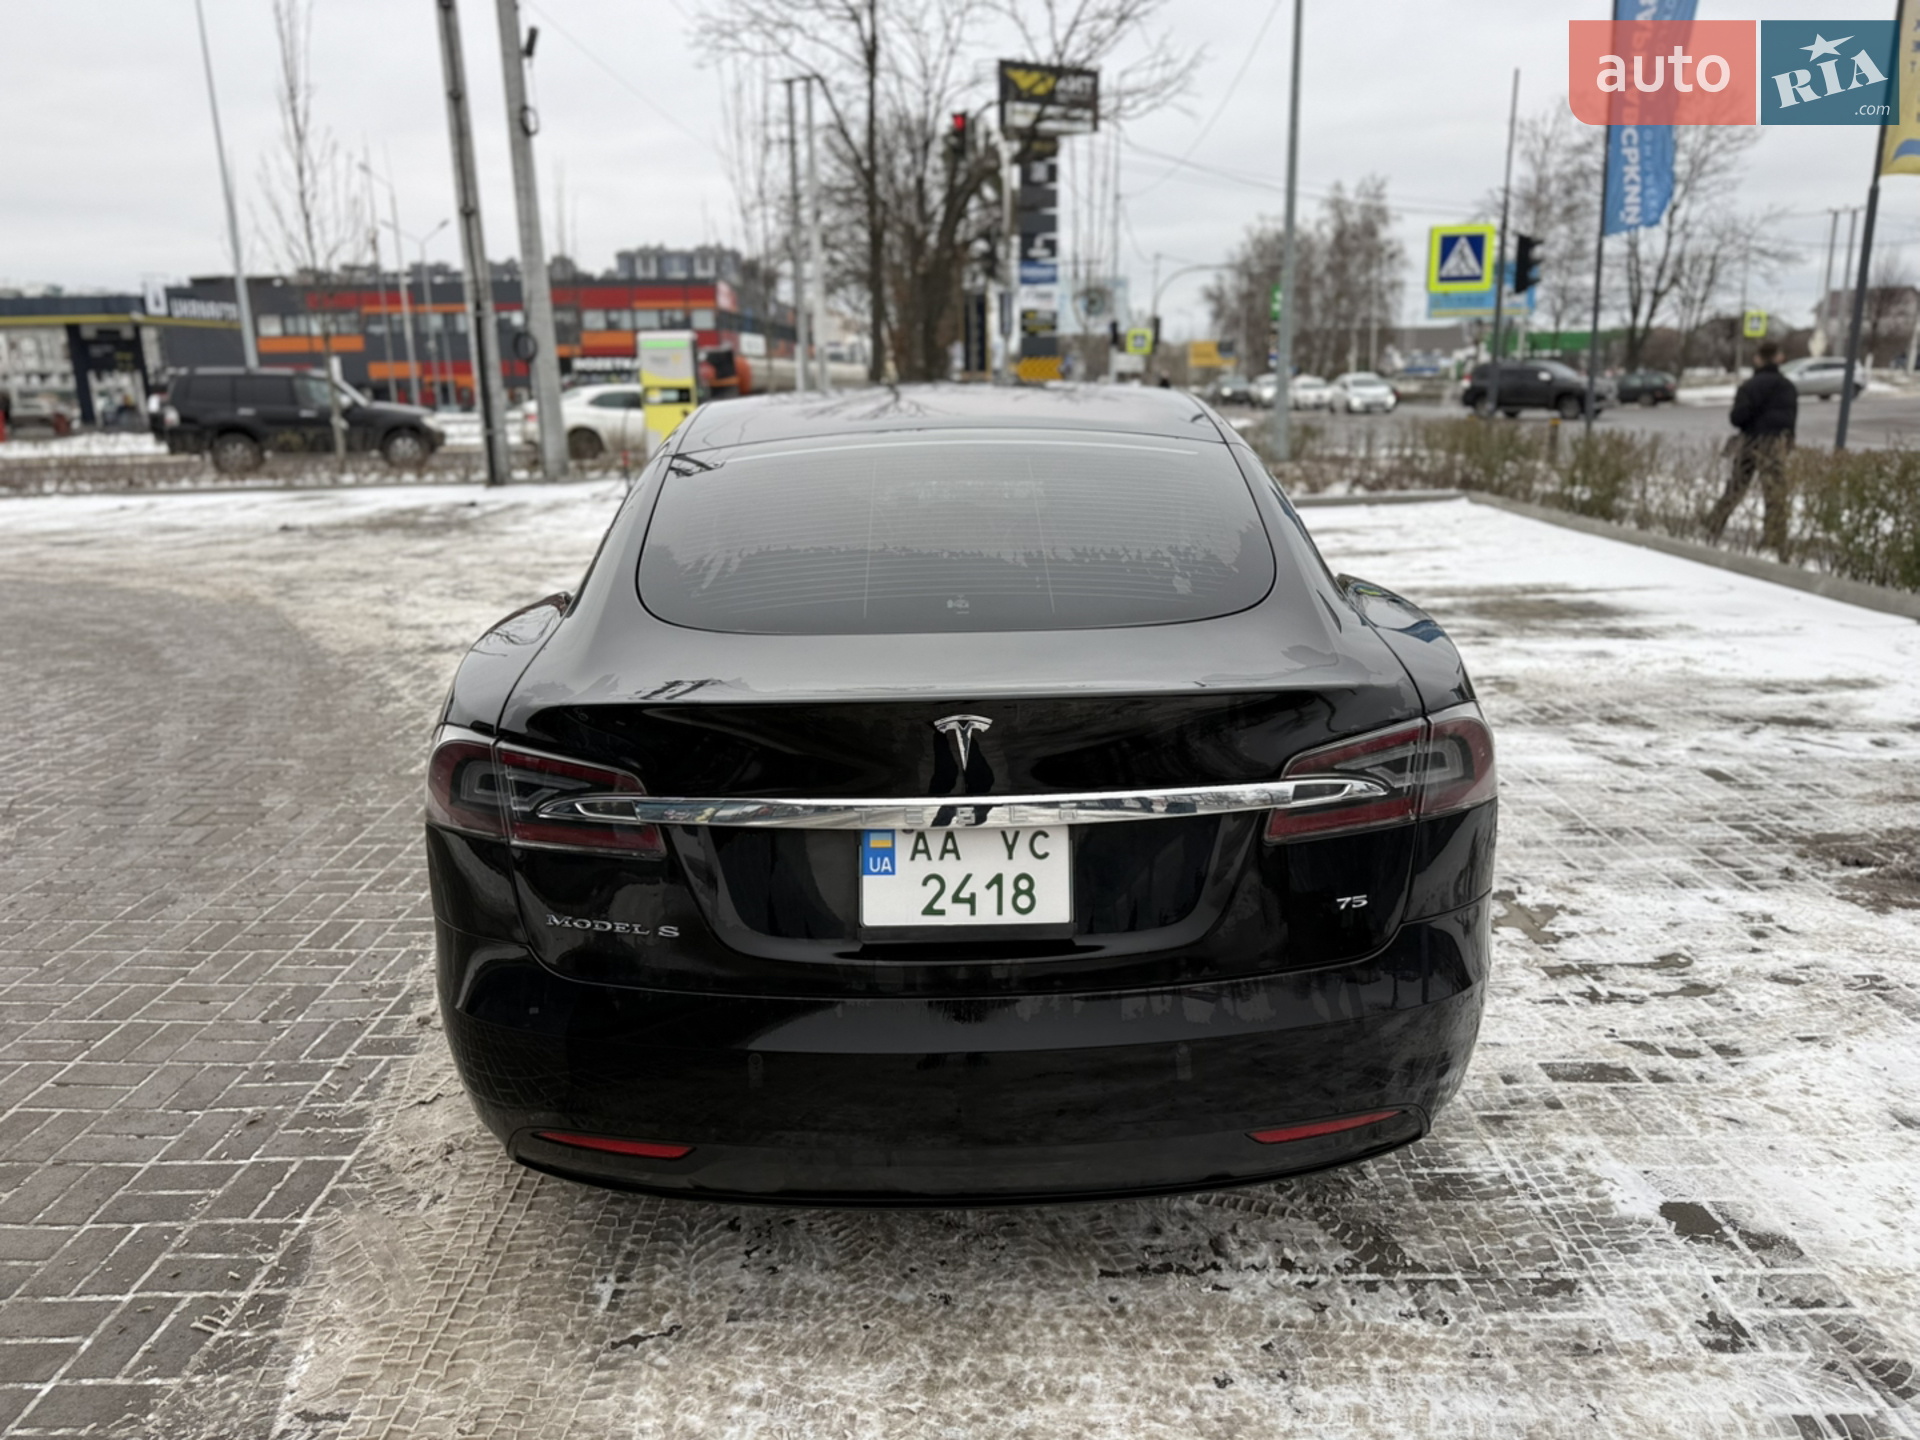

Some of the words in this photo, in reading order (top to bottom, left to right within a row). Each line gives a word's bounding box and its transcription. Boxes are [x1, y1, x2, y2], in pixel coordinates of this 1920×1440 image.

[853, 802, 1078, 825] TESLA
[910, 830, 961, 861] AA
[1000, 830, 1050, 861] YC
[869, 856, 893, 873] UA
[921, 872, 1036, 916] 2418
[1336, 894, 1368, 910] 75
[546, 914, 650, 935] MODEL
[658, 925, 680, 938] S
